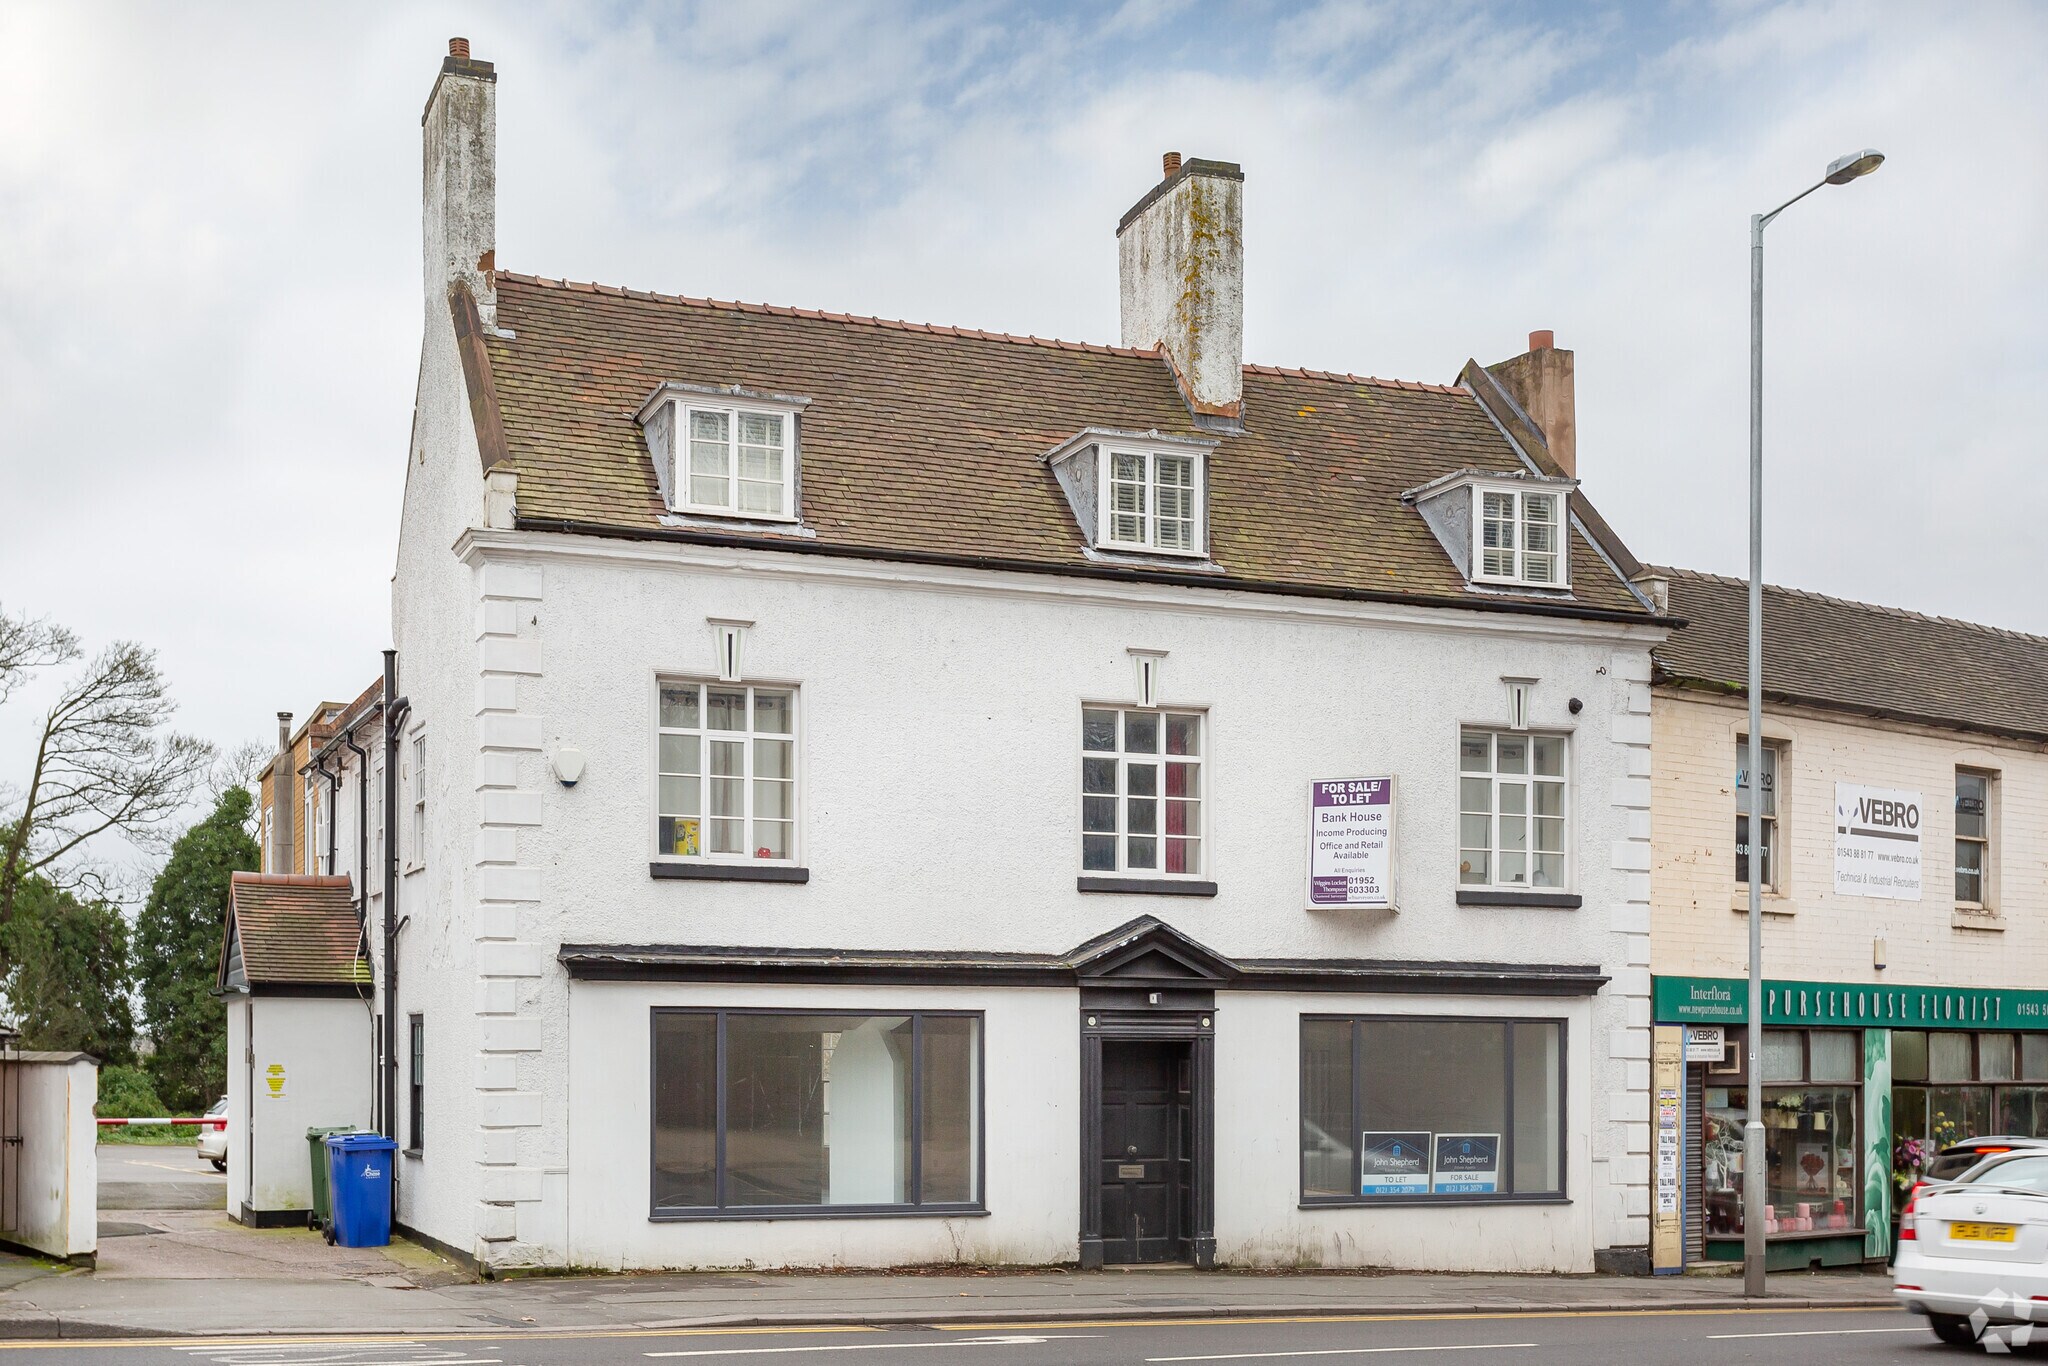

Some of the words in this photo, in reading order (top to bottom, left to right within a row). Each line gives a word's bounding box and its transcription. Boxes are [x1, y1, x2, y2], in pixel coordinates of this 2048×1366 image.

[1742, 769, 1773, 786] VRO
[1322, 783, 1345, 794] FOR
[1348, 781, 1382, 793] SALE/
[1331, 794, 1348, 805] TO
[1349, 793, 1371, 804] LET
[1322, 813, 1347, 823] Bank
[1350, 812, 1382, 822] House
[1859, 797, 1919, 829] VEBRO
[1316, 829, 1345, 837] Income
[1346, 827, 1387, 837] Producing
[1319, 841, 1343, 850] Office
[1344, 841, 1360, 850] and
[1360, 840, 1384, 849] Retail
[1333, 851, 1369, 860] Available
[1837, 847, 1853, 857] 01543
[1867, 851, 1874, 860] 77
[1877, 853, 1919, 865] www.vebro.co.uk
[1348, 876, 1375, 885] 01952
[1863, 873, 1867, 884] &
[1868, 875, 1893, 887] Industrial
[1348, 886, 1380, 894] 603303
[1690, 985, 1731, 1001] Interflora
[1678, 1003, 1743, 1017] www.newpursehouse.co.uk
[1768, 989, 1906, 1019] PURSEHOUSE
[1920, 993, 2001, 1021] FLORIST
[2017, 1003, 2039, 1016] 01543
[1692, 1030, 1719, 1041] VEBRO
[1373, 1158, 1389, 1168] John
[1390, 1157, 1420, 1168] Shepherd
[1443, 1155, 1458, 1165] John
[1459, 1155, 1489, 1165] Shepherd
[1385, 1176, 1395, 1184] TO
[1395, 1176, 1407, 1184] LET
